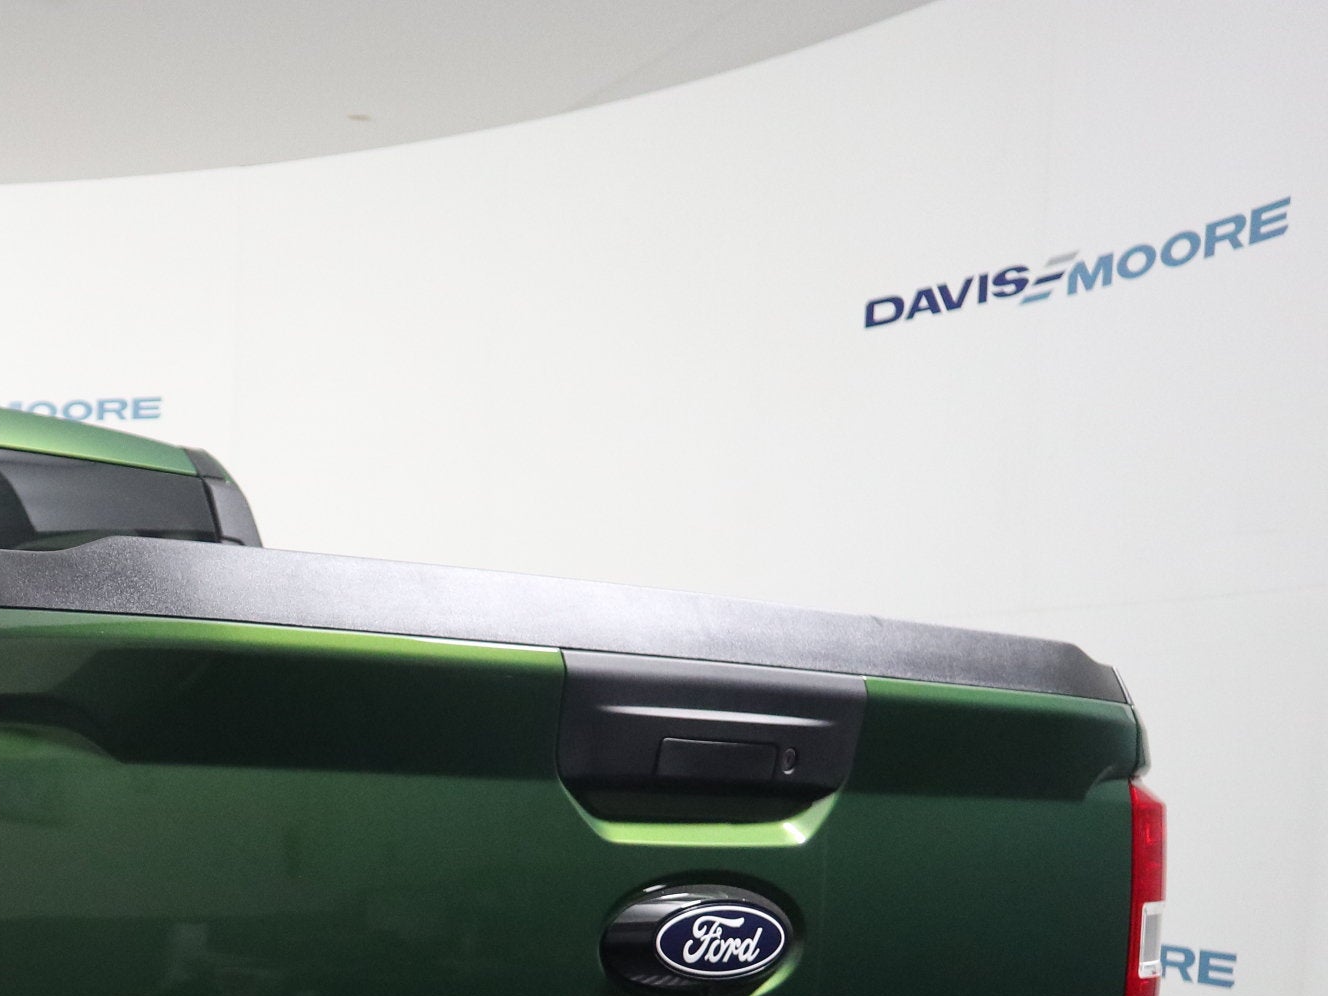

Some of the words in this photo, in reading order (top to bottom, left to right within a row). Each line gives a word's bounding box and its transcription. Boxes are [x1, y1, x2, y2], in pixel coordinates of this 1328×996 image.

[864, 265, 1029, 328] DAVIS
[1067, 197, 1291, 296] MOORE
[683, 915, 763, 964] Ford
[1161, 944, 1237, 988] RE
